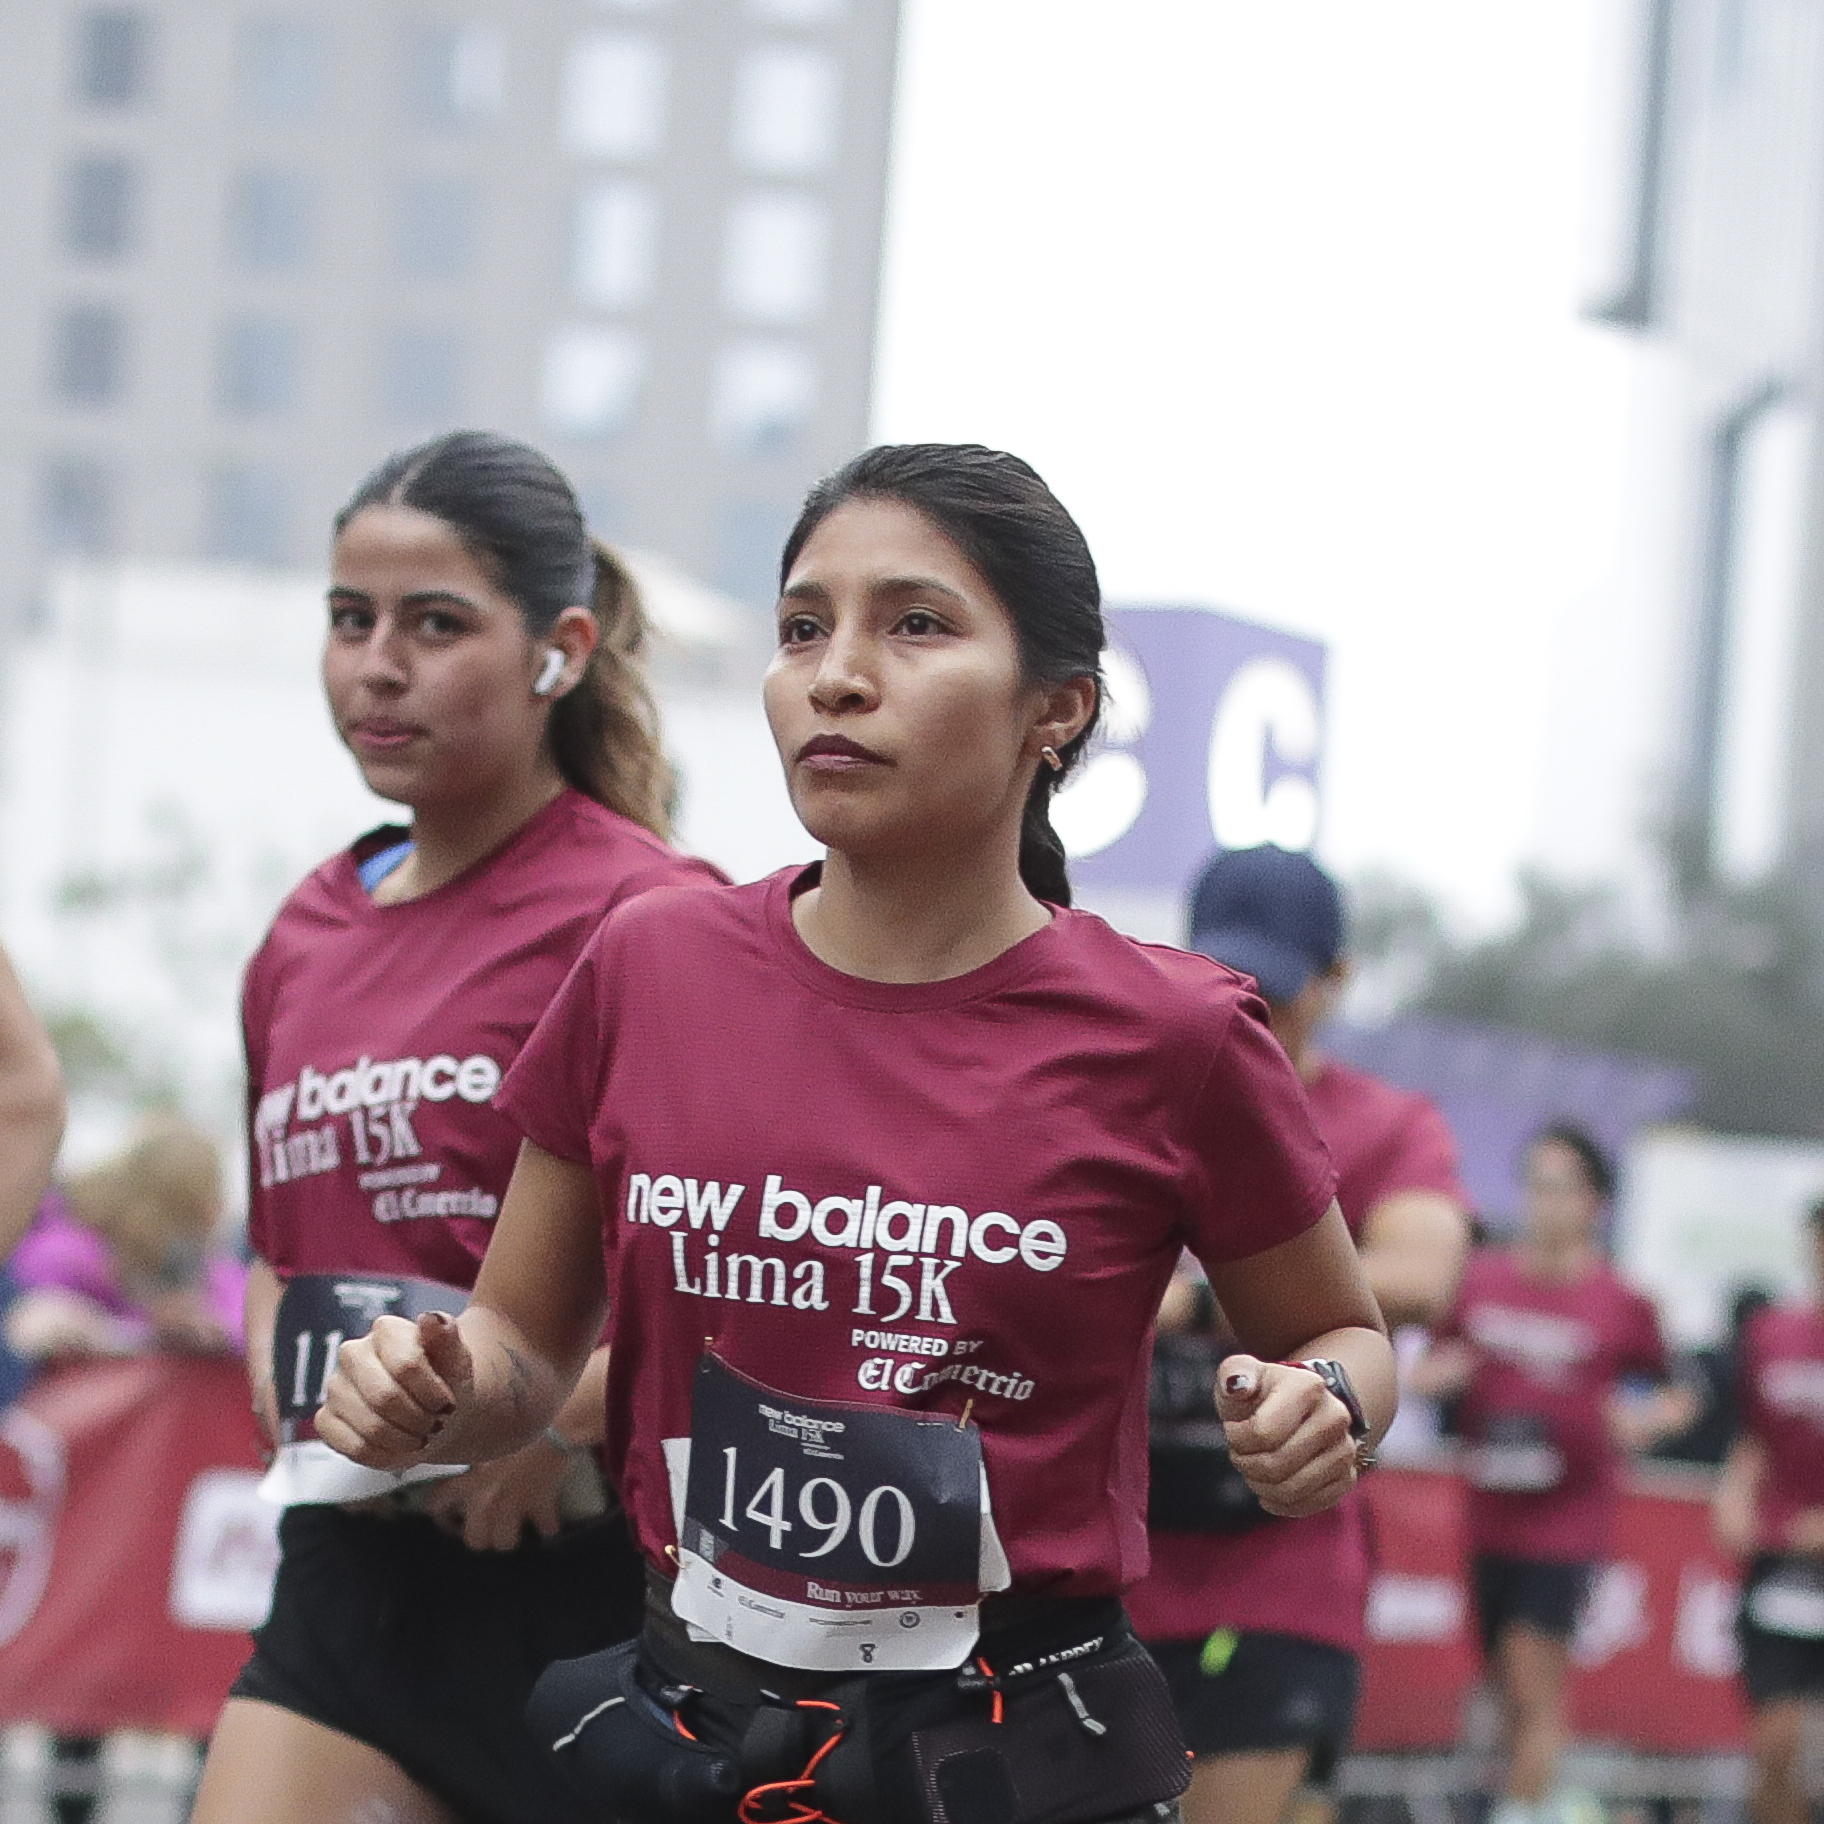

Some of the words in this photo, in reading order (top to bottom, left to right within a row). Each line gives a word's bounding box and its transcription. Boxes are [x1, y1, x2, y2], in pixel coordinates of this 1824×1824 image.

[296, 1053, 502, 1122] balance
[349, 1100, 423, 1167] 15K
[626, 1172, 746, 1231] new
[758, 1174, 1068, 1272] balance
[669, 1230, 830, 1311] Lima
[851, 1251, 964, 1325] 15K
[851, 1328, 949, 1356] POWERED
[952, 1340, 984, 1356] BY
[719, 1446, 917, 1567] 1490
[807, 1581, 842, 1603] Run
[844, 1591, 885, 1609] your
